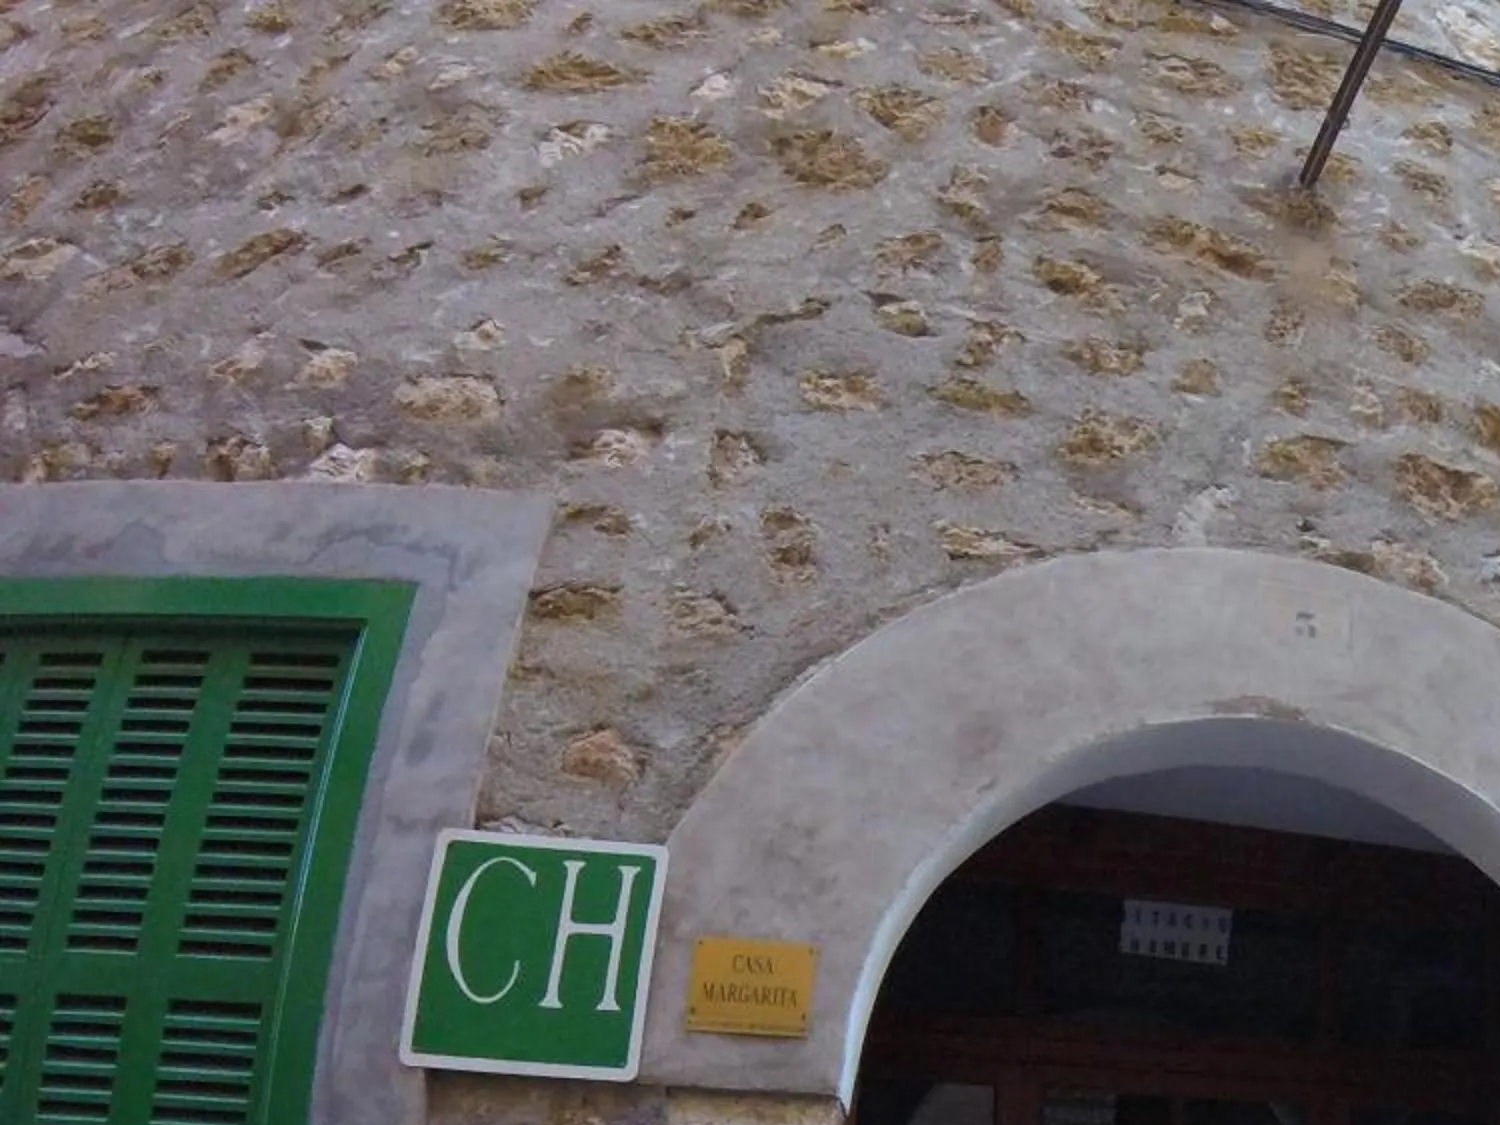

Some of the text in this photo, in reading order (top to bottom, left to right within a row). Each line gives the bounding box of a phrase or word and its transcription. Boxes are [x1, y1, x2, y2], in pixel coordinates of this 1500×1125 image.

[445, 856, 641, 1011] CH
[732, 953, 776, 976] CASA
[702, 982, 798, 1008] MARGARITA
